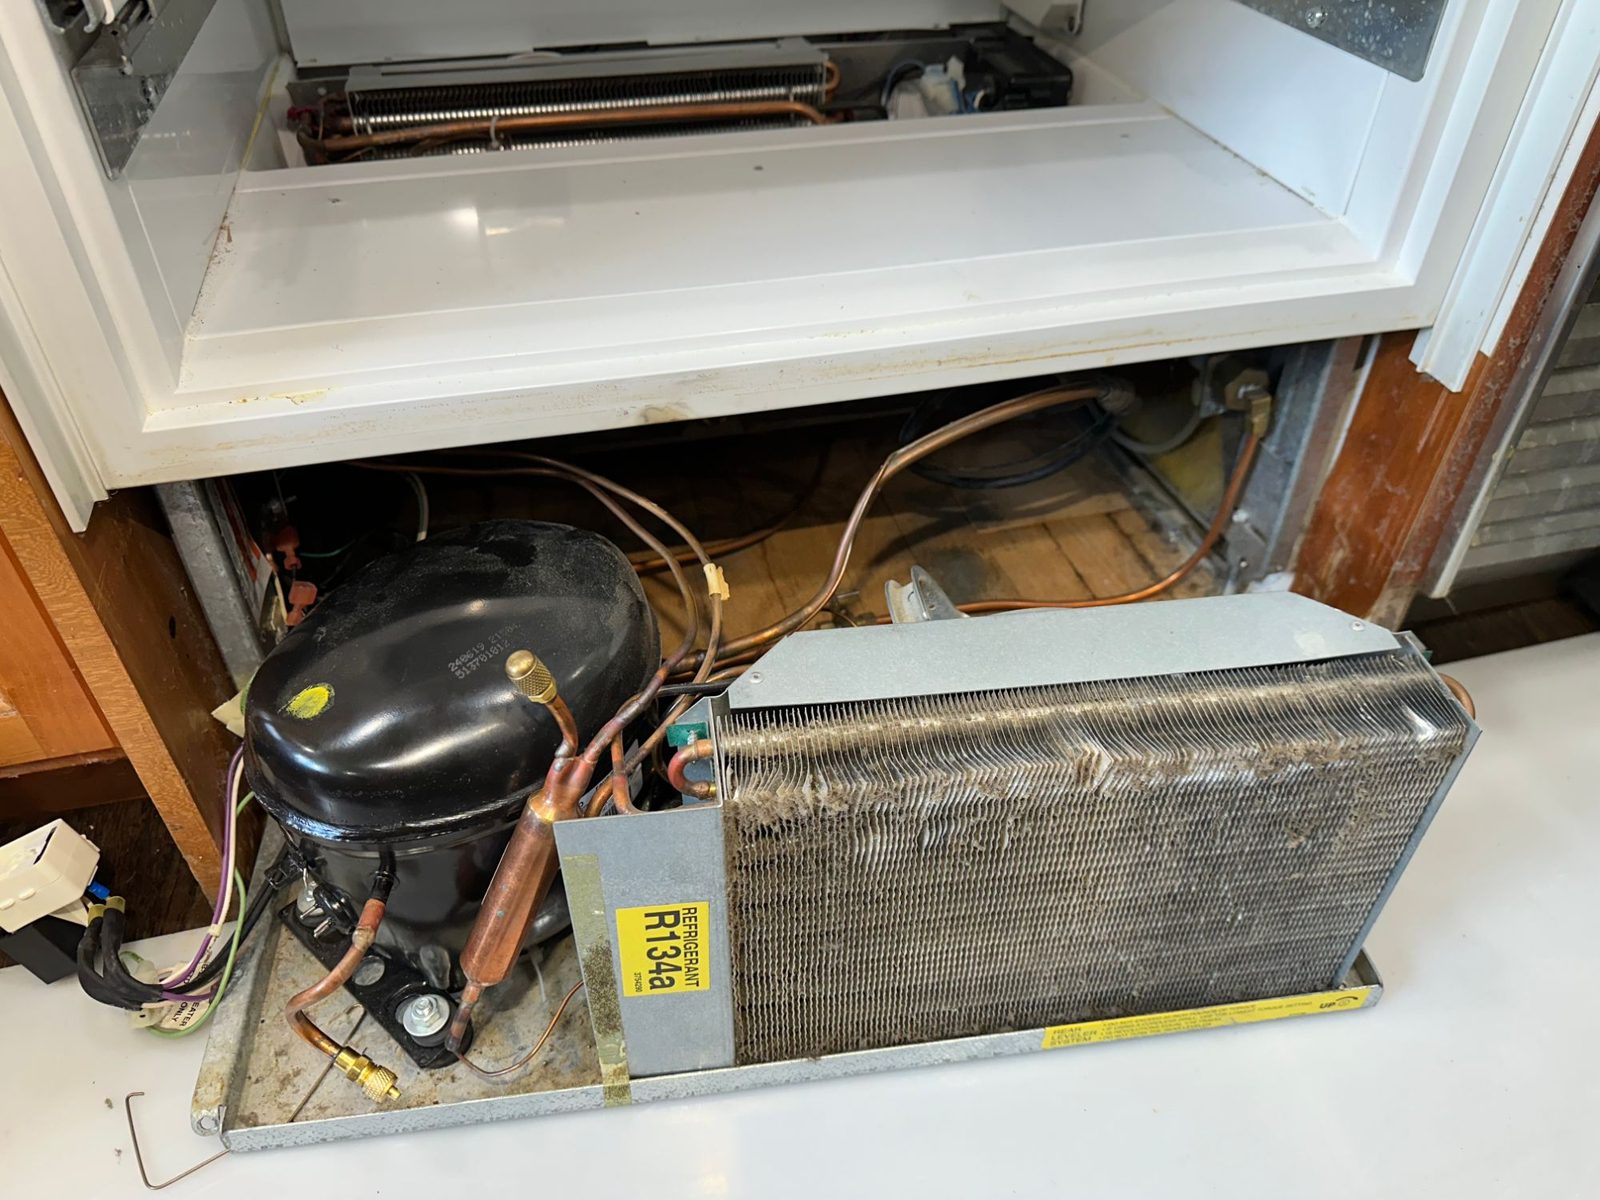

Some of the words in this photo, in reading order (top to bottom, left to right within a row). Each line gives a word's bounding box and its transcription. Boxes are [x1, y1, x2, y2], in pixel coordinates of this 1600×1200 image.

[644, 910, 682, 990] R134a
[682, 907, 699, 987] REFRIGERANT
[171, 1001, 188, 1022] ONLY
[180, 1002, 200, 1027] EATER
[1319, 1001, 1336, 1009] UP
